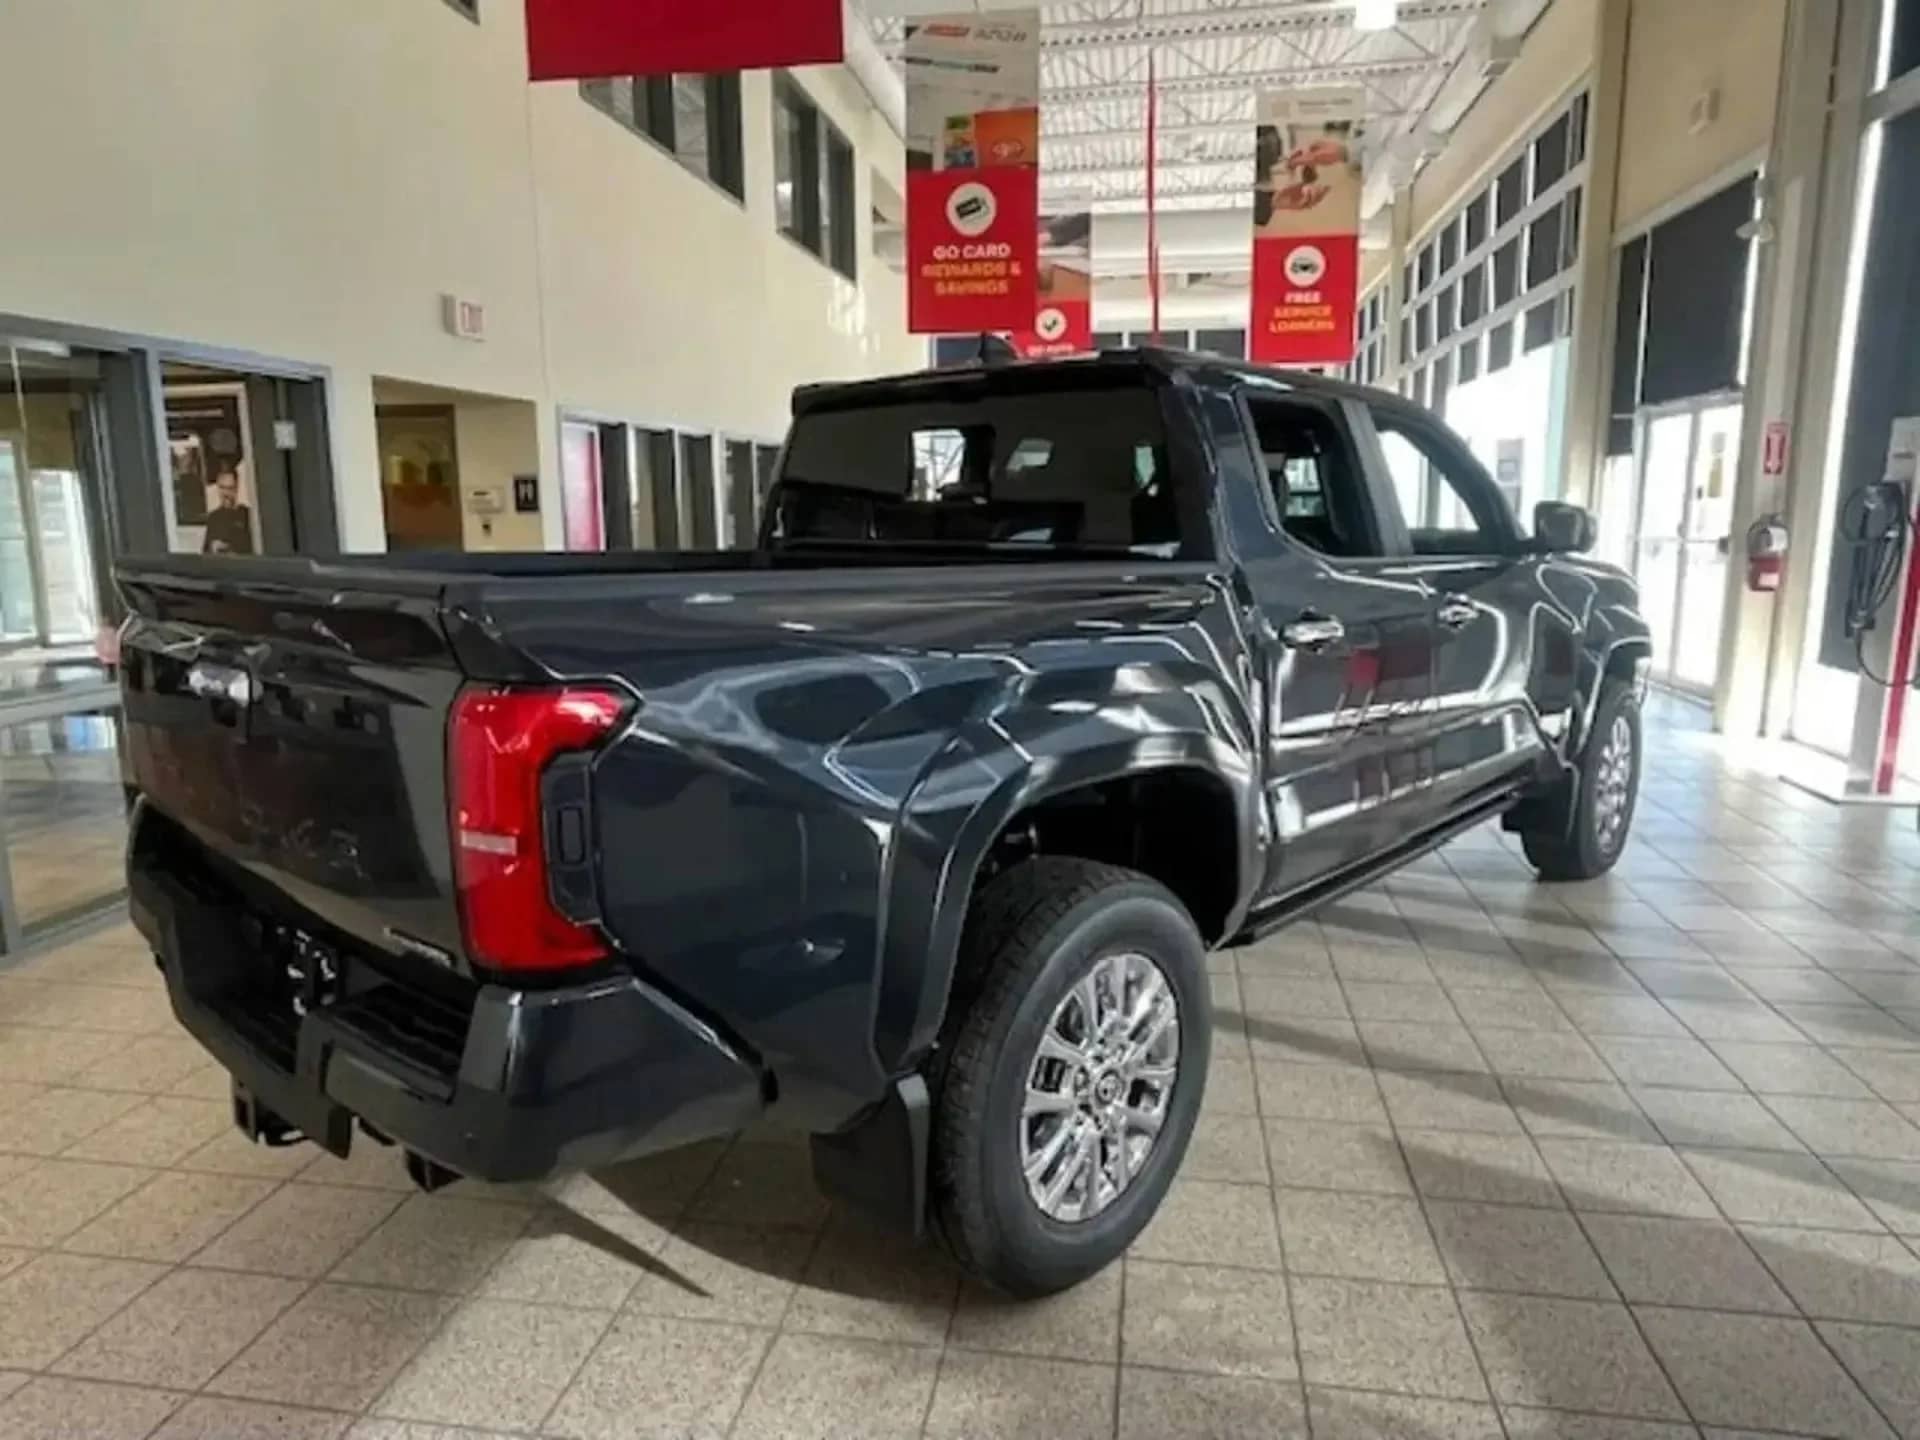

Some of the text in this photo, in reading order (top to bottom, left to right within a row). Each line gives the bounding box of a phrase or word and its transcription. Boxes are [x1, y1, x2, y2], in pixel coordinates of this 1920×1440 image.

[932, 242, 1011, 261] GO CARD
[1284, 290, 1322, 304] FREE
